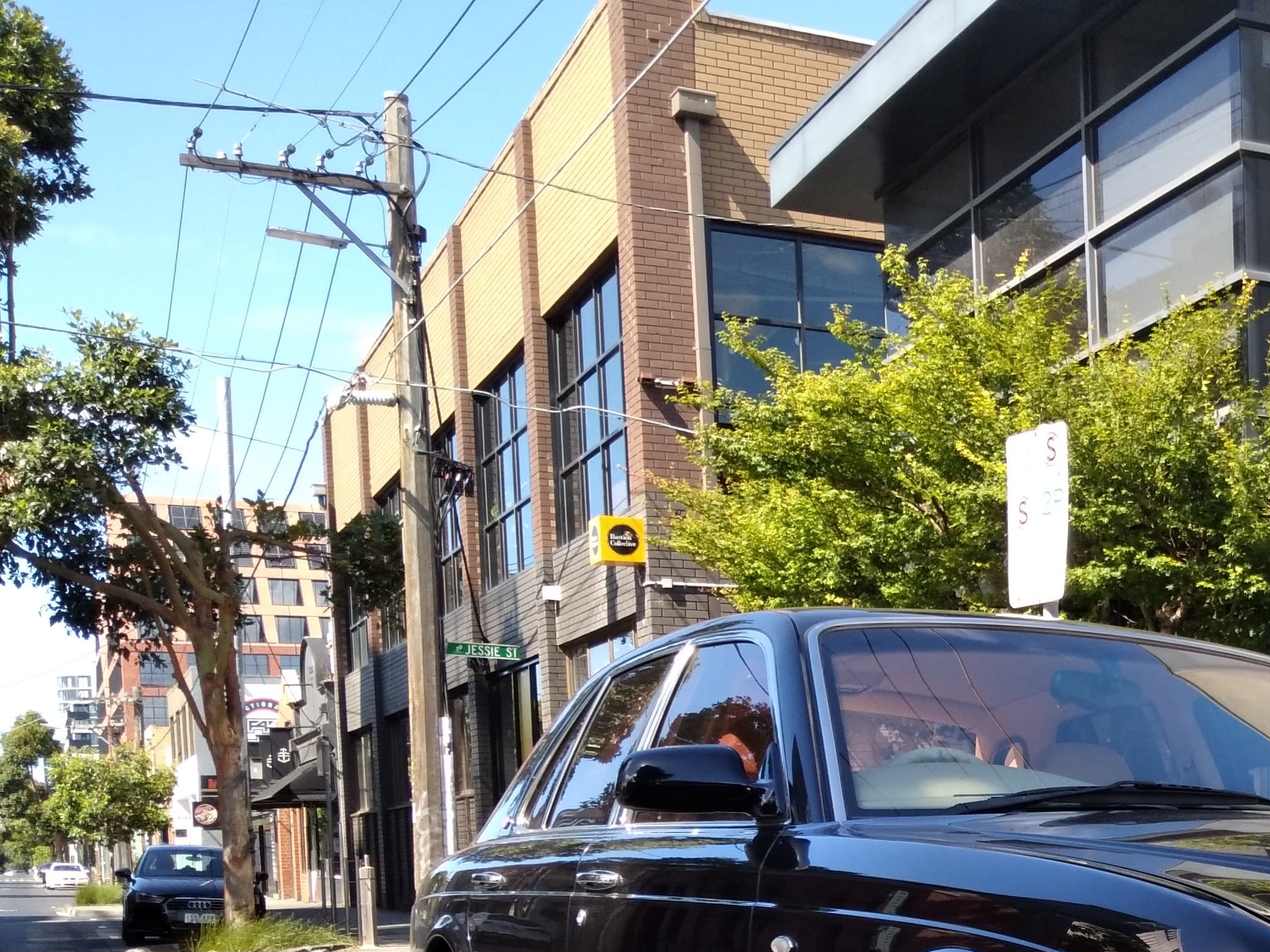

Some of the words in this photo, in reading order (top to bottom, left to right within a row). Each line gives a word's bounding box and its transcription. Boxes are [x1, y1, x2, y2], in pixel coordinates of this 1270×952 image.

[610, 533, 632, 541] Bastion
[610, 540, 637, 548] Collective
[465, 644, 501, 657] JESSIE
[506, 647, 518, 658] ST
